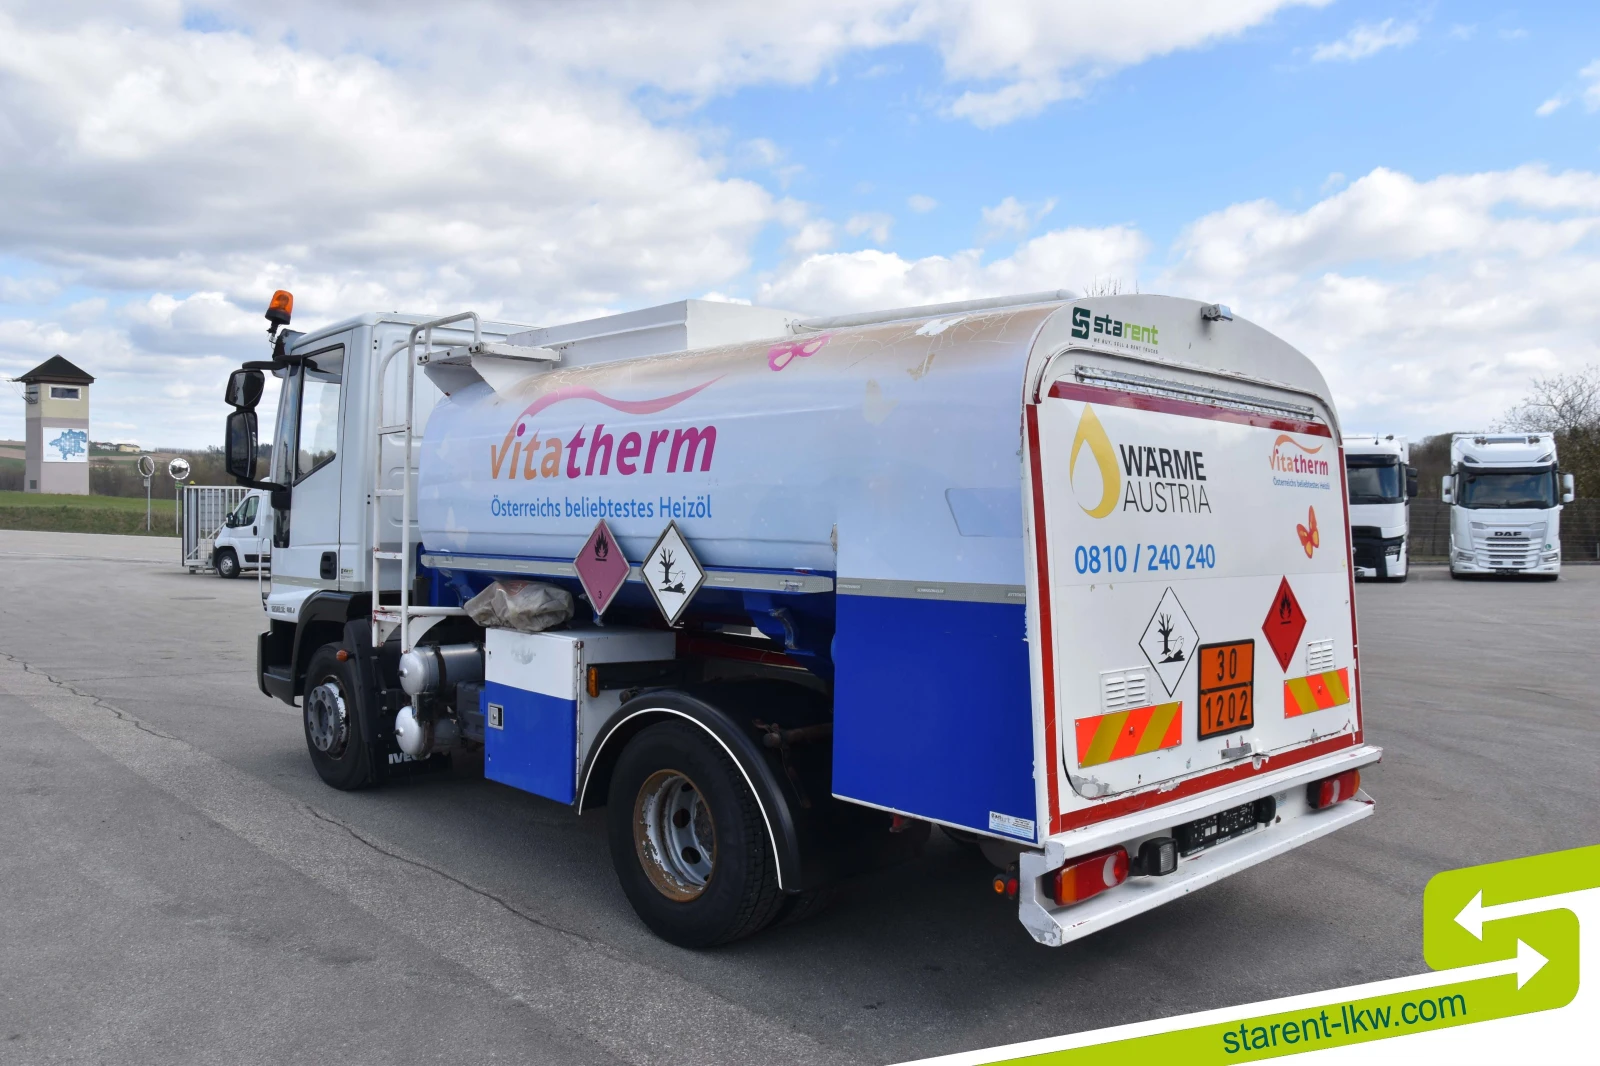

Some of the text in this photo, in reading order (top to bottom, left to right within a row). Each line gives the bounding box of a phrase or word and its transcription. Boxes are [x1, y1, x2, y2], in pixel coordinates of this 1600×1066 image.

[1094, 314, 1158, 345] starent
[490, 422, 717, 481] vitatherm
[1119, 443, 1207, 481] WÄRME
[491, 494, 712, 519] Österreichs beliebtestes Heizöl
[1123, 480, 1212, 514] AUSTRIA
[1074, 543, 1216, 574] 0810 / 240 240
[597, 590, 603, 600] 3
[1217, 648, 1237, 682] 30
[1205, 689, 1248, 730] 1202
